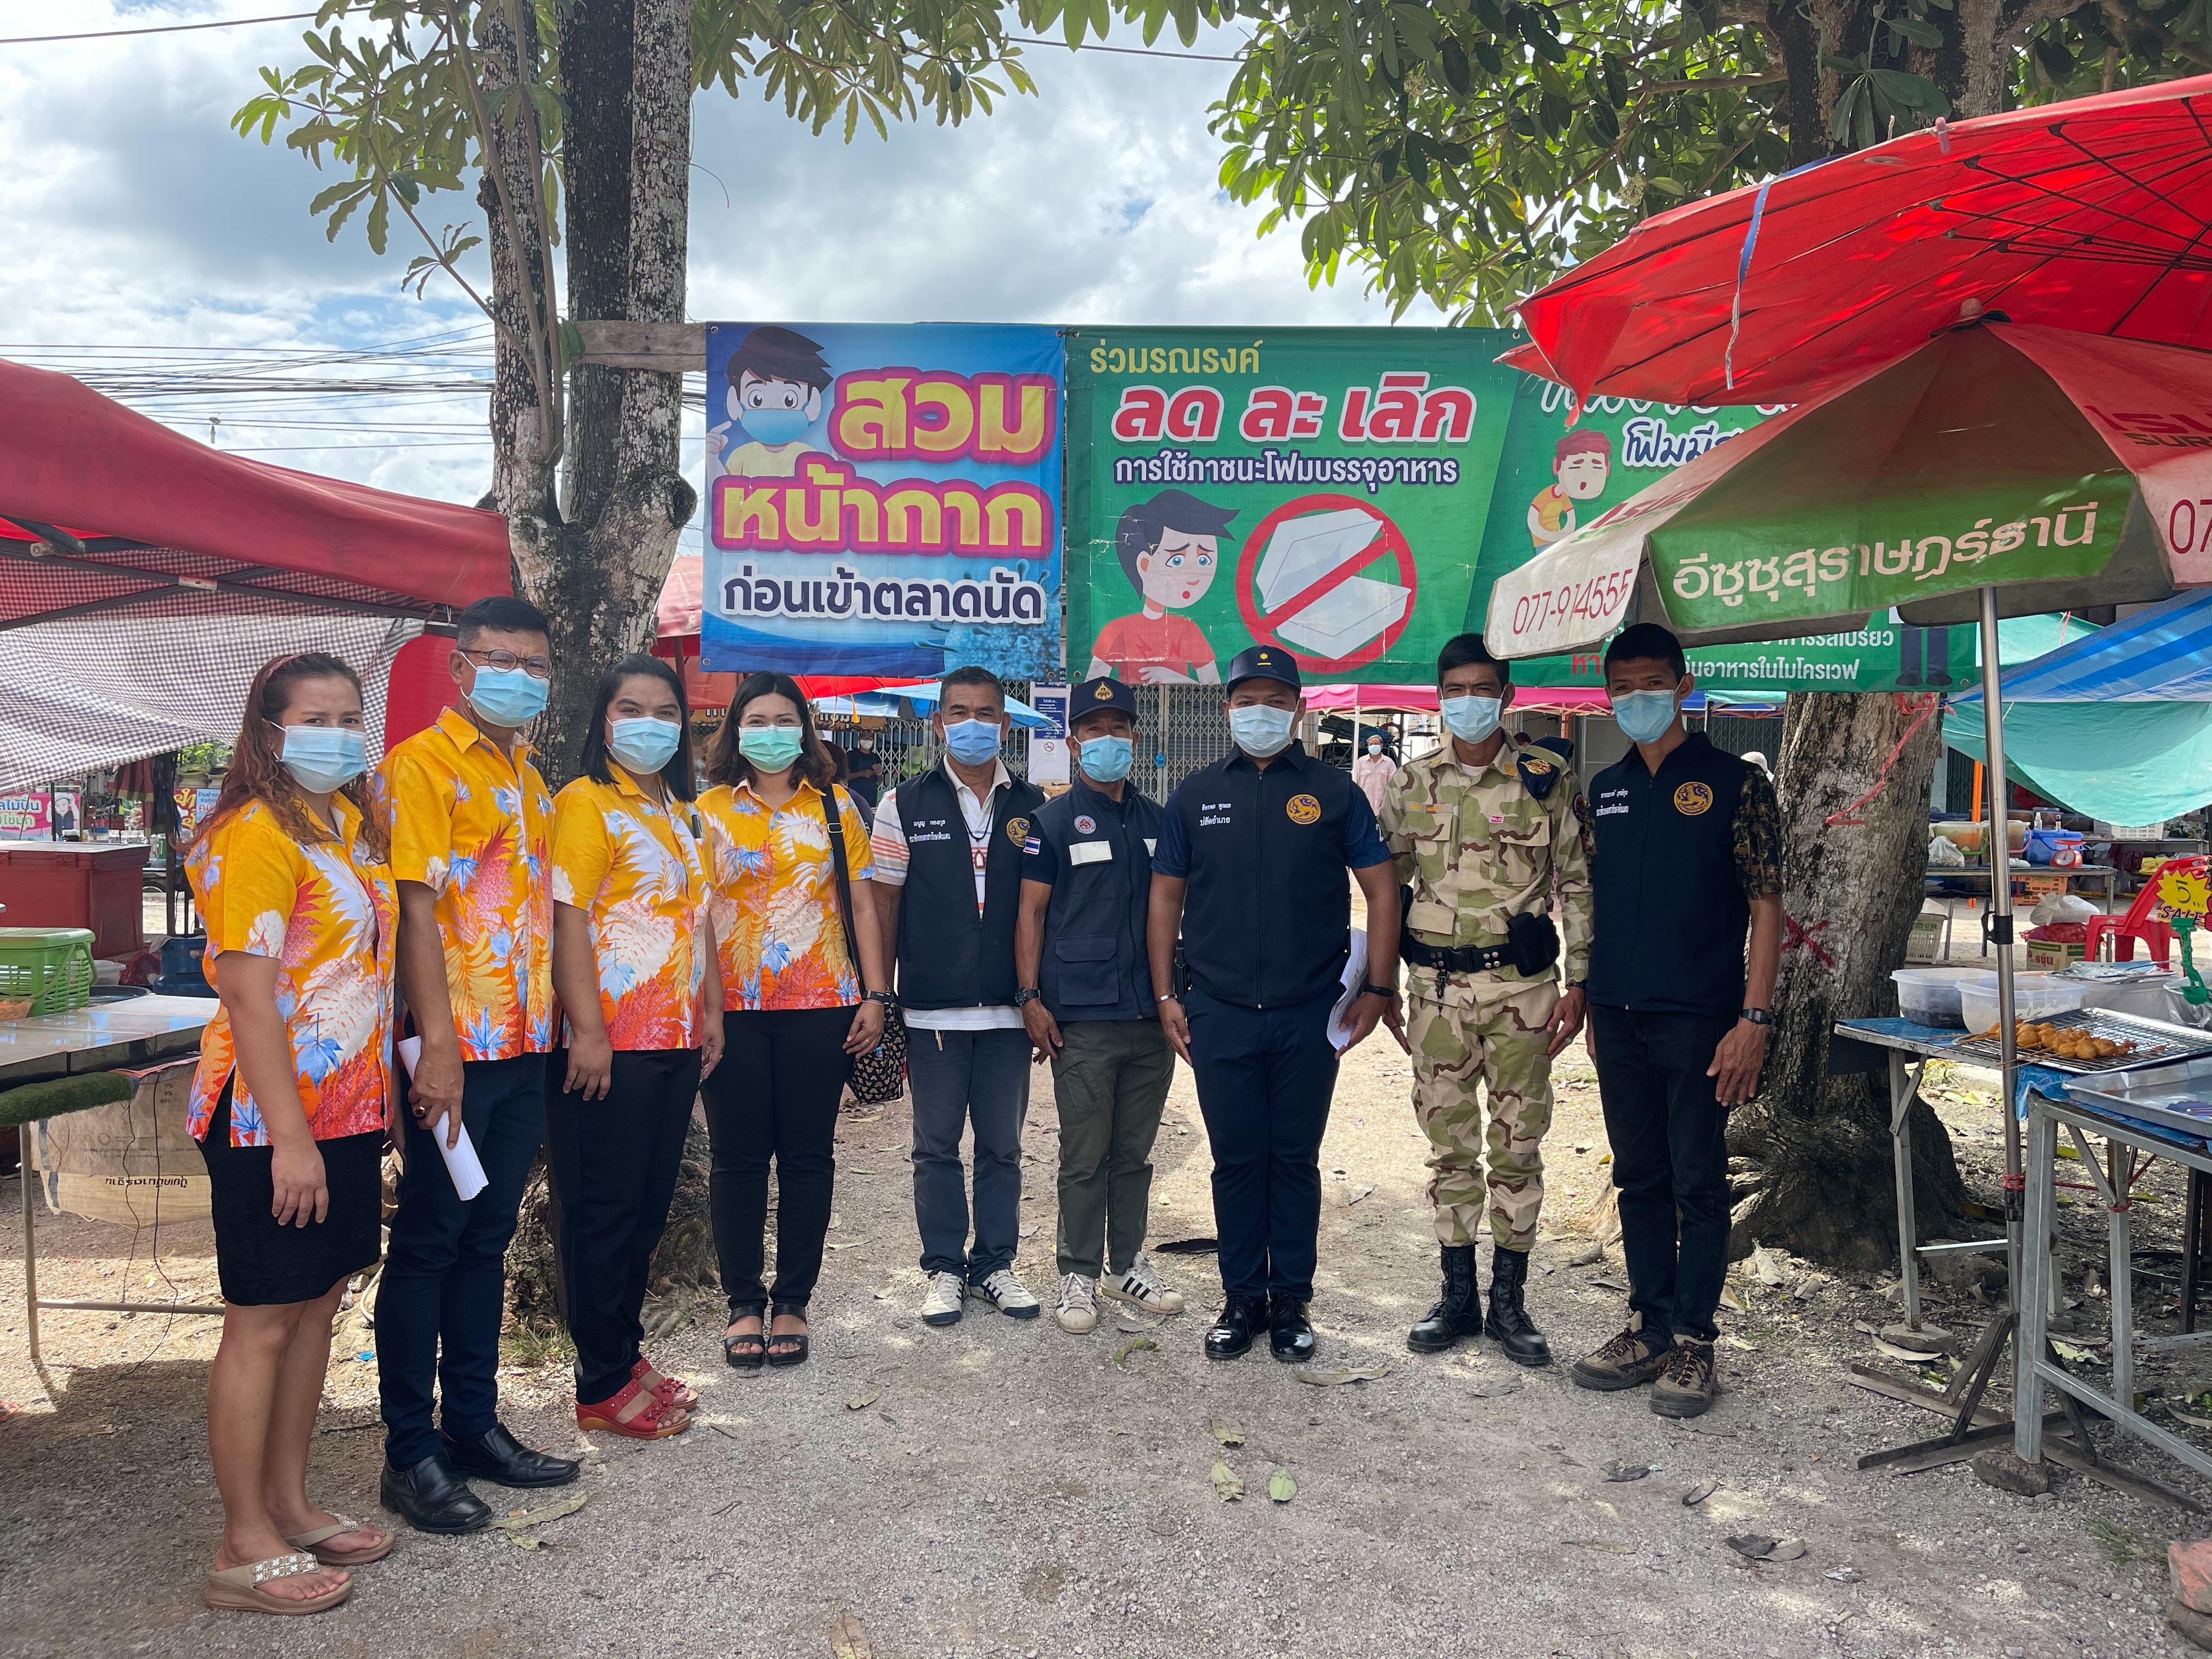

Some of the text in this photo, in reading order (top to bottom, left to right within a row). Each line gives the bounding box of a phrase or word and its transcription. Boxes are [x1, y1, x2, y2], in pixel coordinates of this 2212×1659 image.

[1090, 338, 1263, 374] ร่วมรณรงค์
[838, 377, 1046, 454] สวม
[1115, 375, 1475, 440] ลด ละ เลิก
[1627, 421, 1740, 464] โฟมมี
[2123, 432, 2212, 448] SUR
[1116, 450, 1458, 492] การใช้ภาชนะโฟมบรรจุอาหาร
[723, 462, 1043, 548] หน้ากาก
[723, 565, 1042, 619] ก่อนเข้าตลาดนัด
[1513, 568, 1633, 635] 077-914555
[1199, 815, 1231, 826] ปลัดอำเภอ
